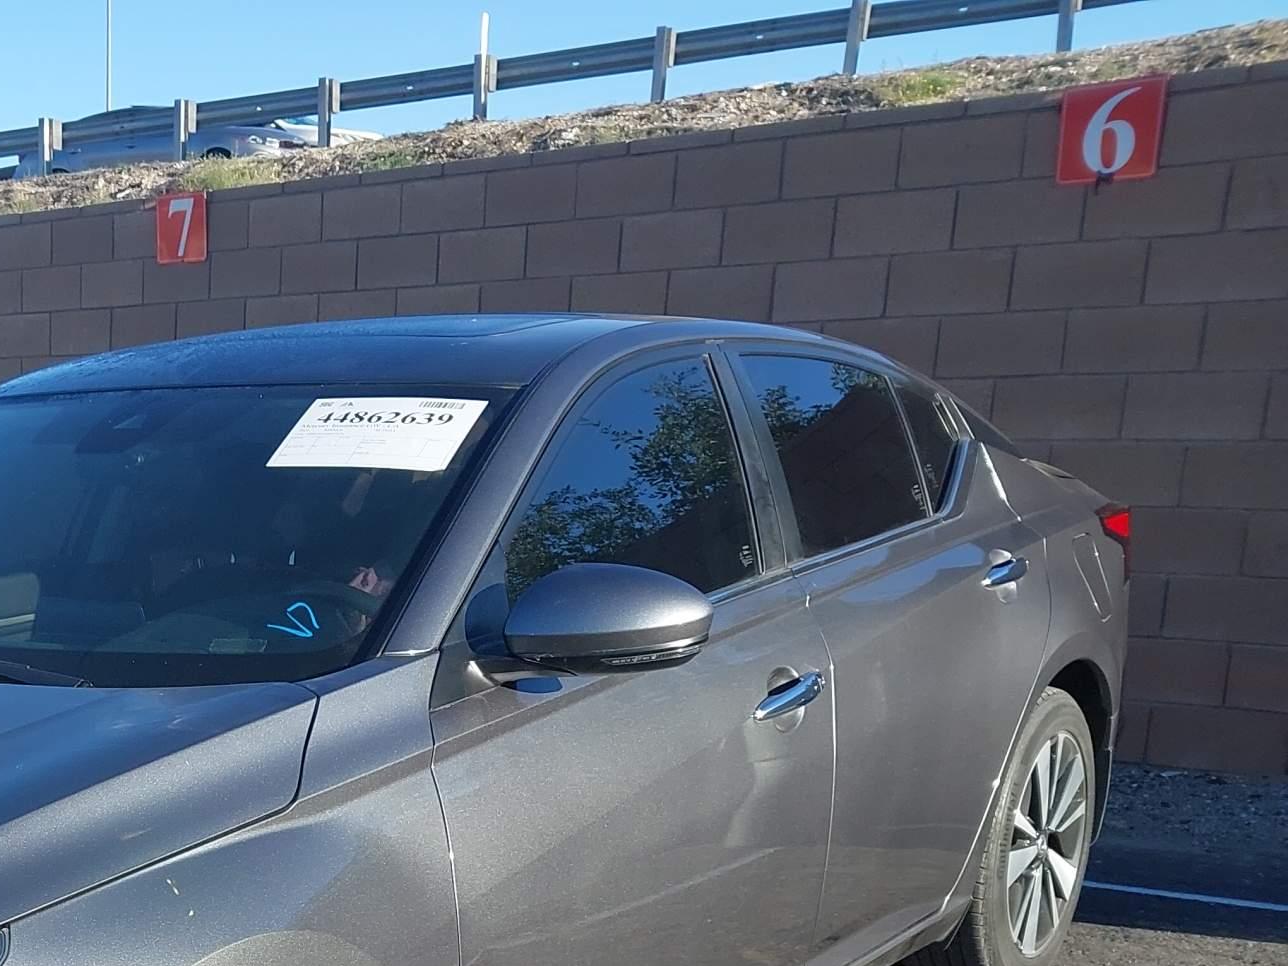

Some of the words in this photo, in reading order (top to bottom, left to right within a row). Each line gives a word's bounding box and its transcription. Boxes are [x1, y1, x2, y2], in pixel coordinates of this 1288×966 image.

[1082, 86, 1143, 174] 6
[168, 197, 194, 257] 7
[316, 411, 455, 426] 44862639
